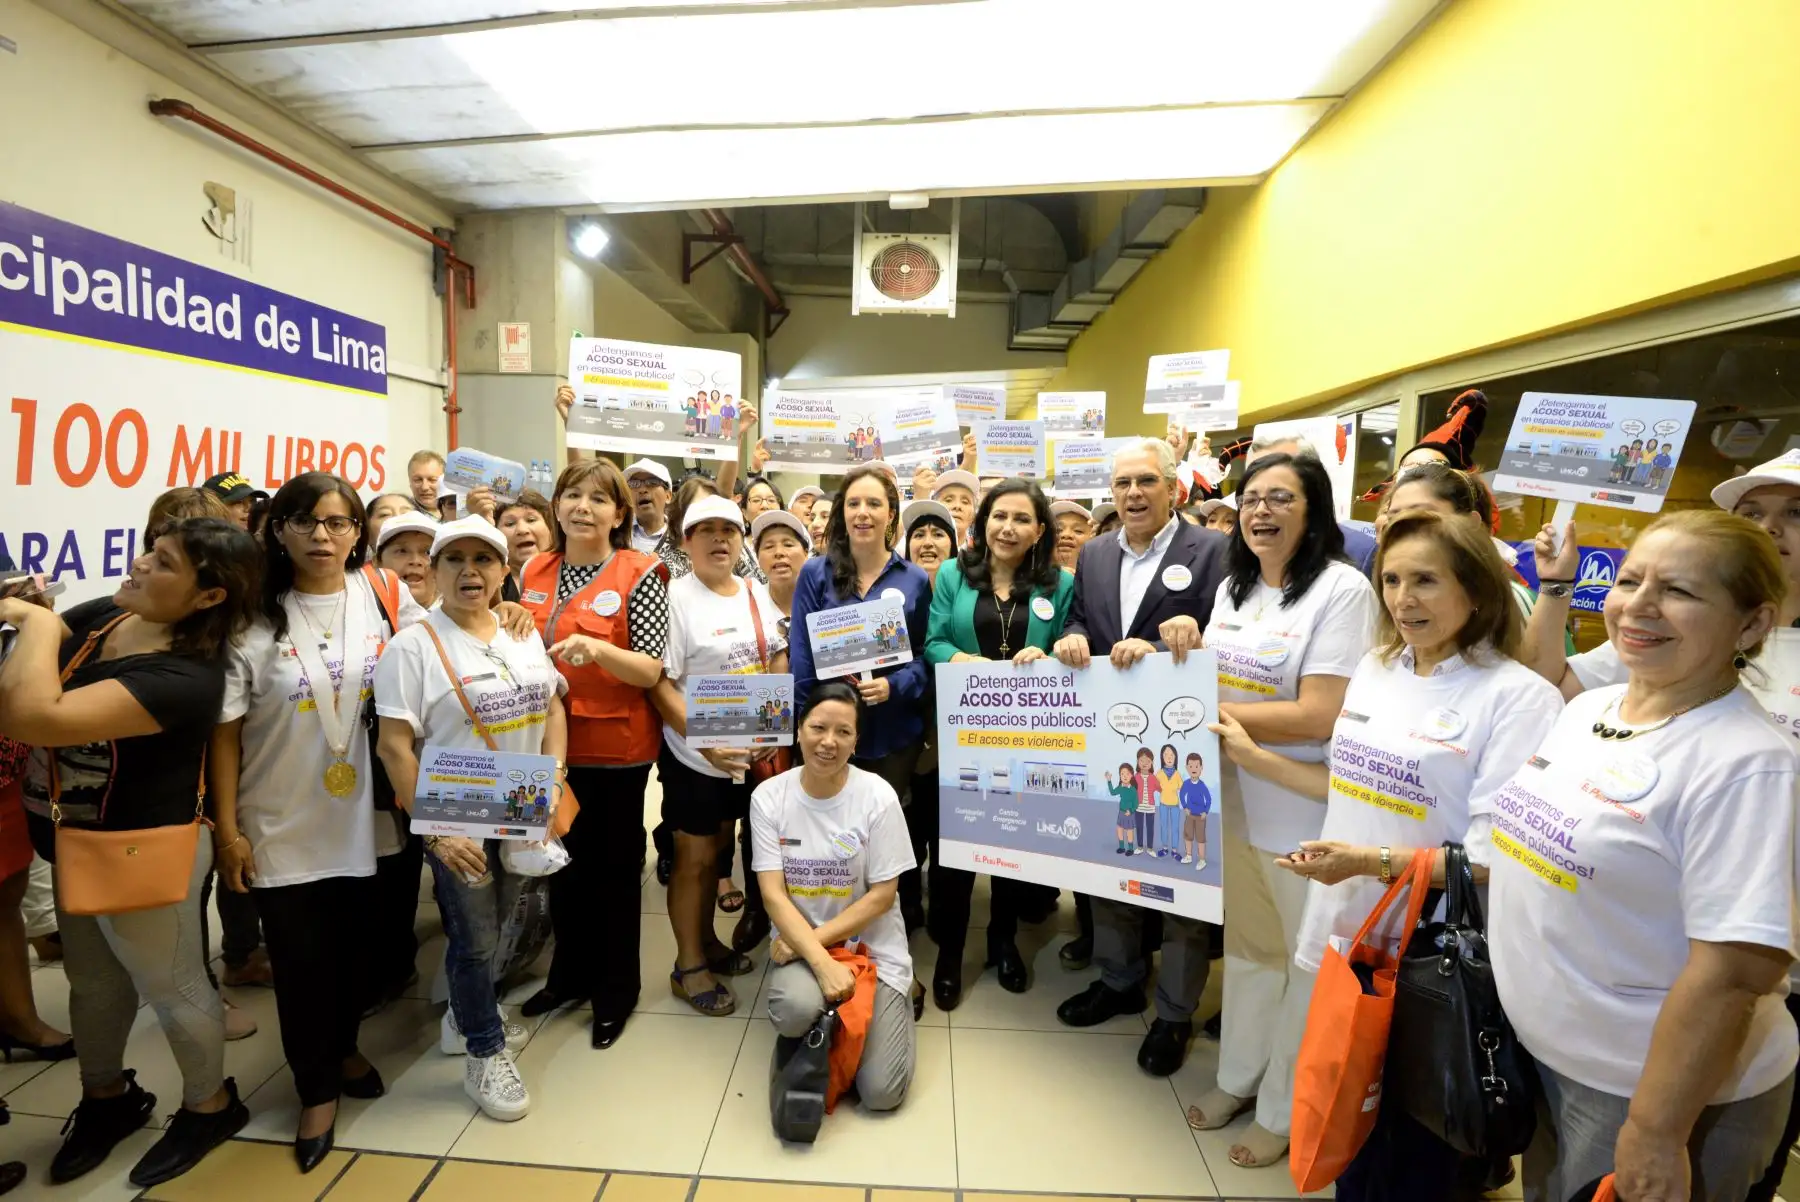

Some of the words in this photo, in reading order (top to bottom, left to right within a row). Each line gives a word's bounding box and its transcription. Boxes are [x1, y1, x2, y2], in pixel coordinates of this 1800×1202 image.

[0, 235, 243, 341] cipalidad
[255, 305, 301, 354] de
[312, 318, 386, 375] Lima
[591, 344, 653, 358] ¡Detengamos
[655, 352, 663, 360] el
[586, 354, 624, 365] ACOSO
[626, 359, 667, 369] SEXUAL
[577, 364, 589, 372] en
[591, 365, 633, 376] espacios
[1538, 399, 1596, 409] ¡Detengamos
[1532, 408, 1566, 416] ACOSO
[1568, 410, 1607, 419] SEXUAL
[1533, 417, 1571, 426] espacios
[1572, 420, 1614, 429] públicos!
[11, 398, 149, 488] 100
[264, 435, 386, 492] LIBROS
[966, 675, 1057, 691] ¡Detengamos
[1062, 672, 1074, 687] el
[1238, 668, 1283, 686] públicos!
[474, 698, 515, 714] ACOSO
[960, 693, 1013, 707] ACOSO
[1018, 692, 1082, 707] SEXUAL
[481, 709, 525, 723] espacios
[948, 714, 963, 725] en
[967, 712, 1027, 728] espacios
[1031, 712, 1096, 729] públicos!
[967, 733, 978, 744] El
[980, 735, 1010, 745] acoso
[1013, 737, 1024, 746] es
[1028, 735, 1073, 748] violencia
[439, 752, 486, 761] ¡Detengamos
[465, 762, 496, 770] SEXUAL
[1406, 760, 1420, 771] el
[470, 770, 502, 778] públicos!
[1368, 760, 1424, 788] SEXUAL
[1377, 780, 1437, 808] públicos!
[1360, 791, 1371, 800] es
[1373, 797, 1414, 815] violencia
[1564, 817, 1582, 830] el
[1525, 811, 1576, 854] SEXUAL
[1528, 835, 1595, 880] públicos!
[813, 868, 850, 876] SEXUAL
[1513, 848, 1522, 859] es
[1524, 853, 1562, 884] violencia
[822, 876, 858, 887] públicos!
